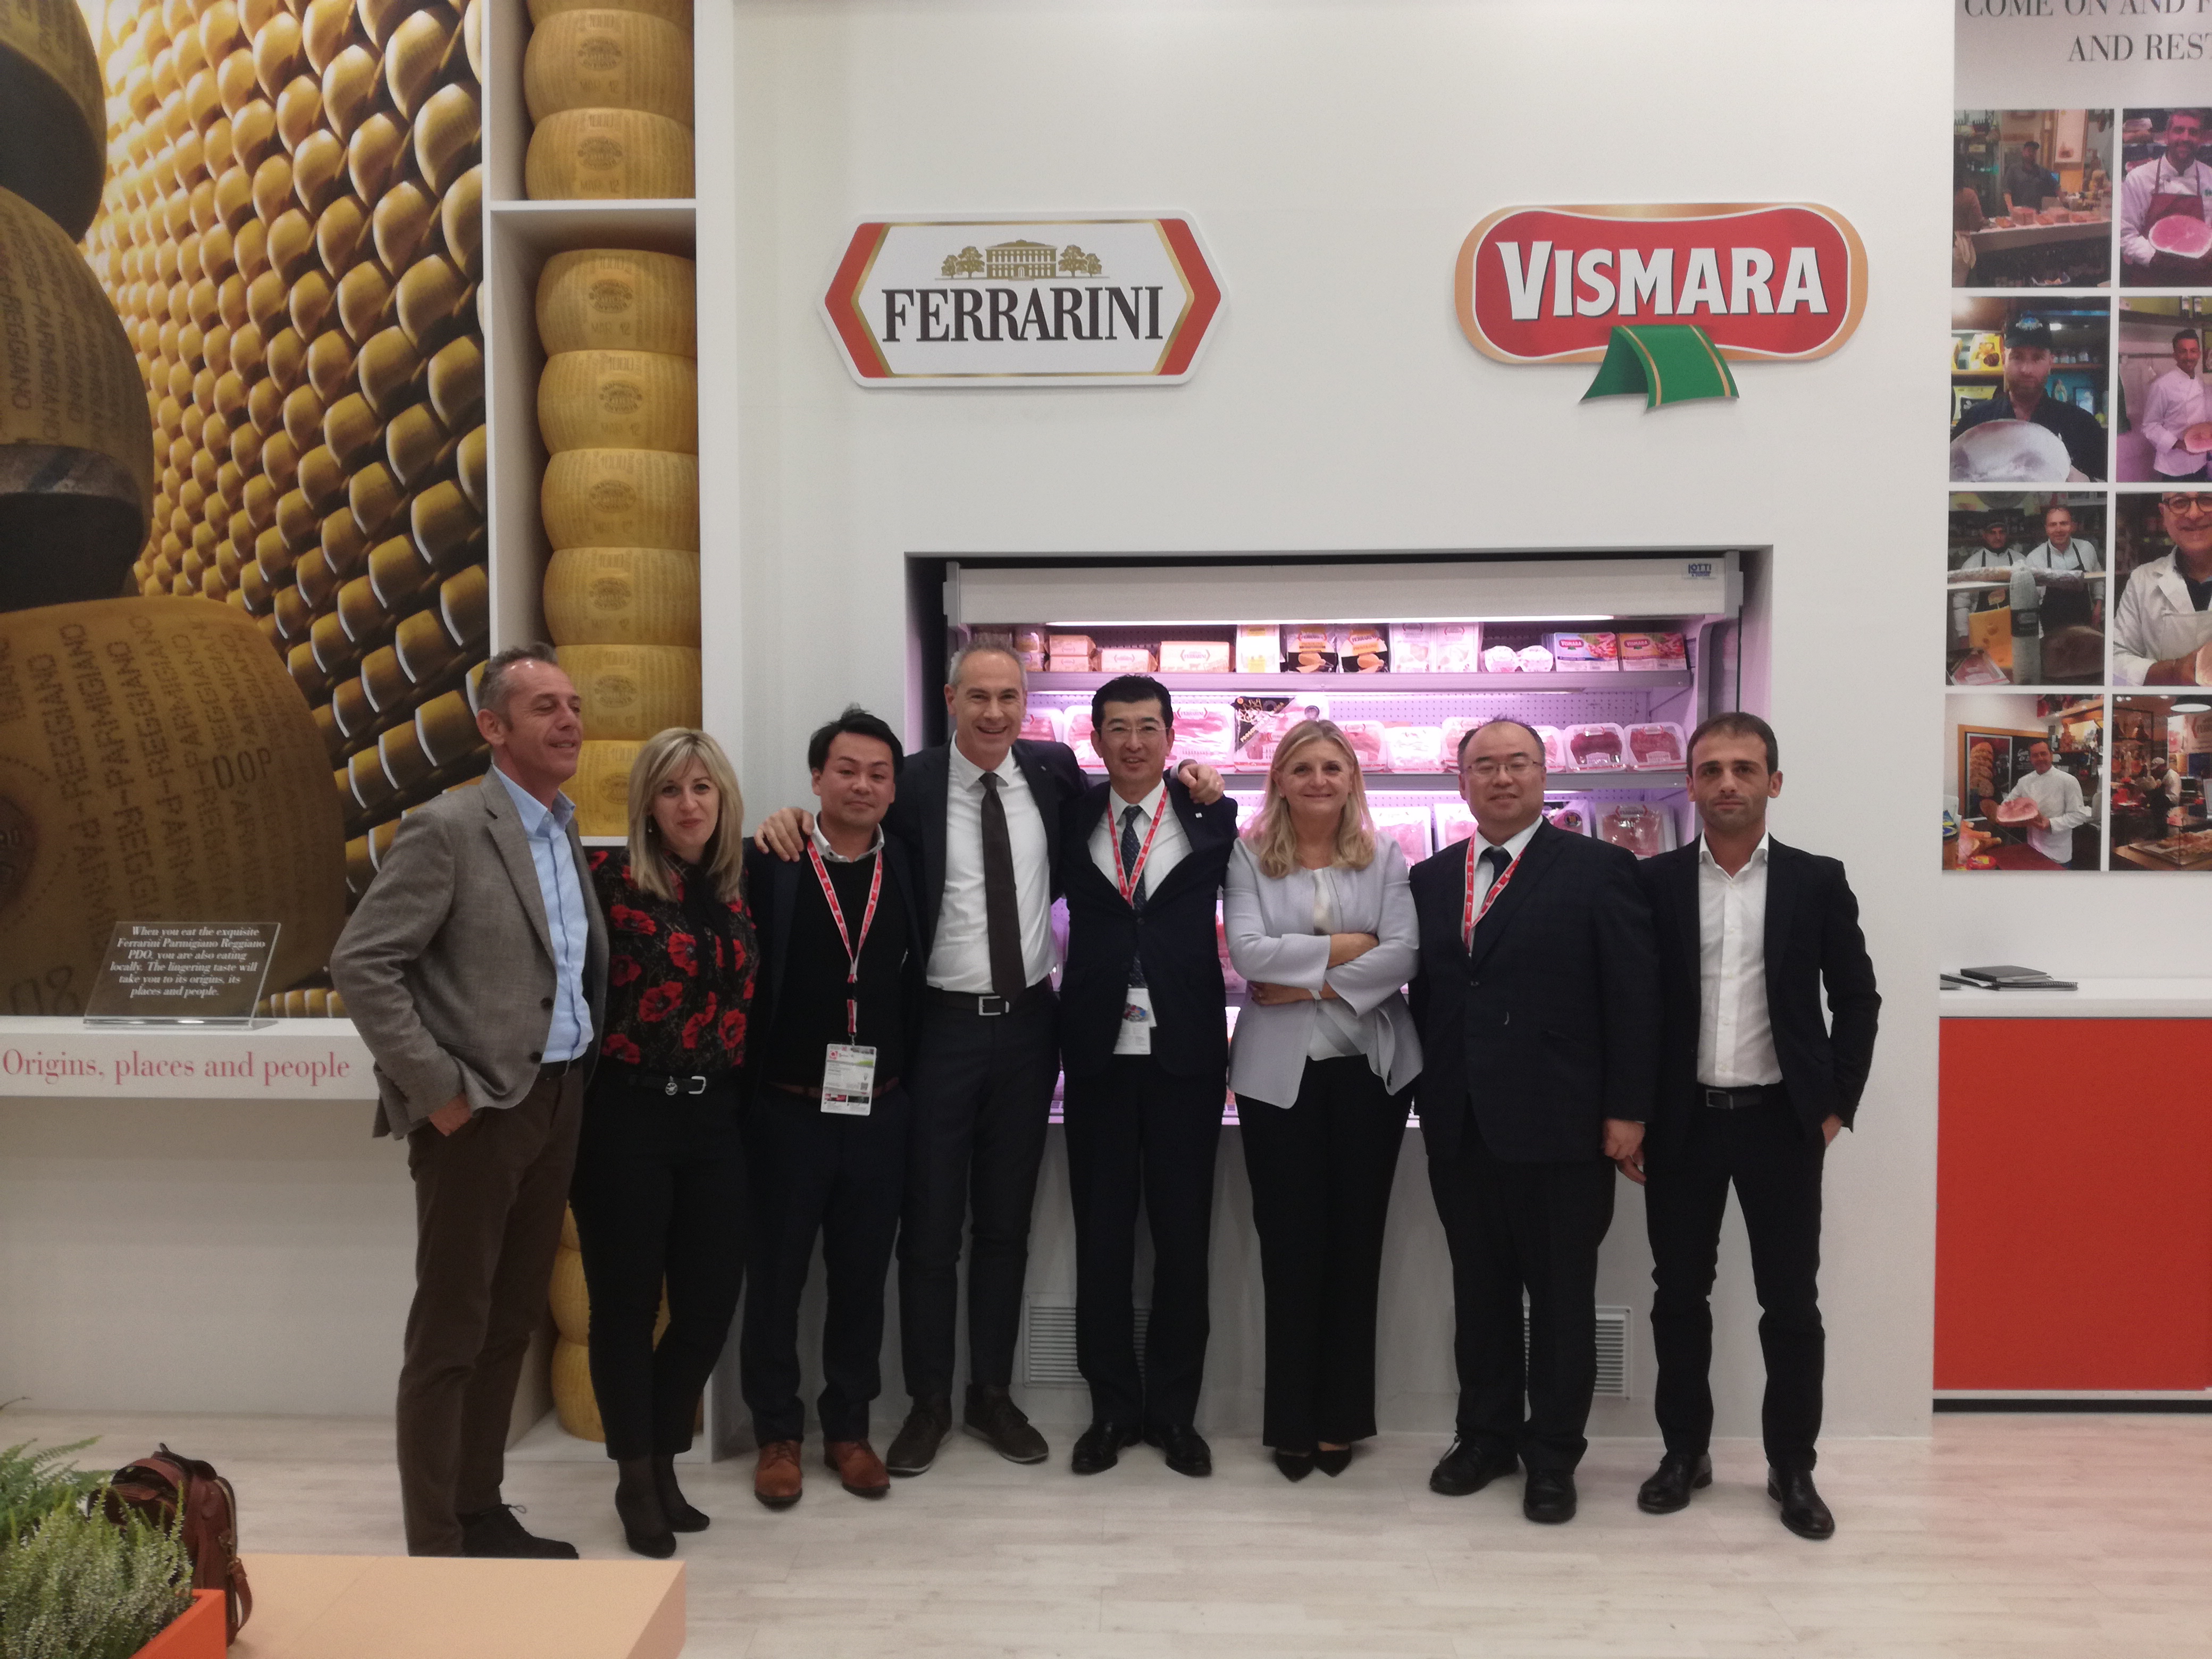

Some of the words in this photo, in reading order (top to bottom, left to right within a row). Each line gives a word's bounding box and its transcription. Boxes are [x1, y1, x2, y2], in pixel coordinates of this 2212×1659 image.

[2067, 35, 2134, 62] AND
[1495, 240, 1828, 321] VISMARA
[883, 286, 1163, 342] FERRARINI
[592, 322, 612, 336] MAR
[619, 322, 631, 336] 12
[211, 747, 272, 791] DOP
[132, 926, 159, 935] When
[161, 929, 179, 940] you
[199, 926, 214, 935] the
[216, 926, 259, 938] exquisite
[117, 938, 161, 948] Ferrarini
[163, 938, 218, 950] Parmigiano
[221, 939, 265, 951] Reggiano
[157, 953, 175, 962] you
[195, 950, 214, 959] also
[216, 952, 248, 962] eating
[148, 962, 165, 971] The
[167, 962, 212, 974] lingering
[239, 962, 258, 971] will
[119, 974, 140, 983] take
[143, 977, 161, 986] you
[130, 986, 161, 998] places
[163, 986, 183, 995] and
[184, 986, 219, 998] people.
[2, 1048, 105, 1085] Origins,
[113, 1050, 195, 1085] places
[204, 1050, 254, 1077] and
[263, 1051, 350, 1086] people
